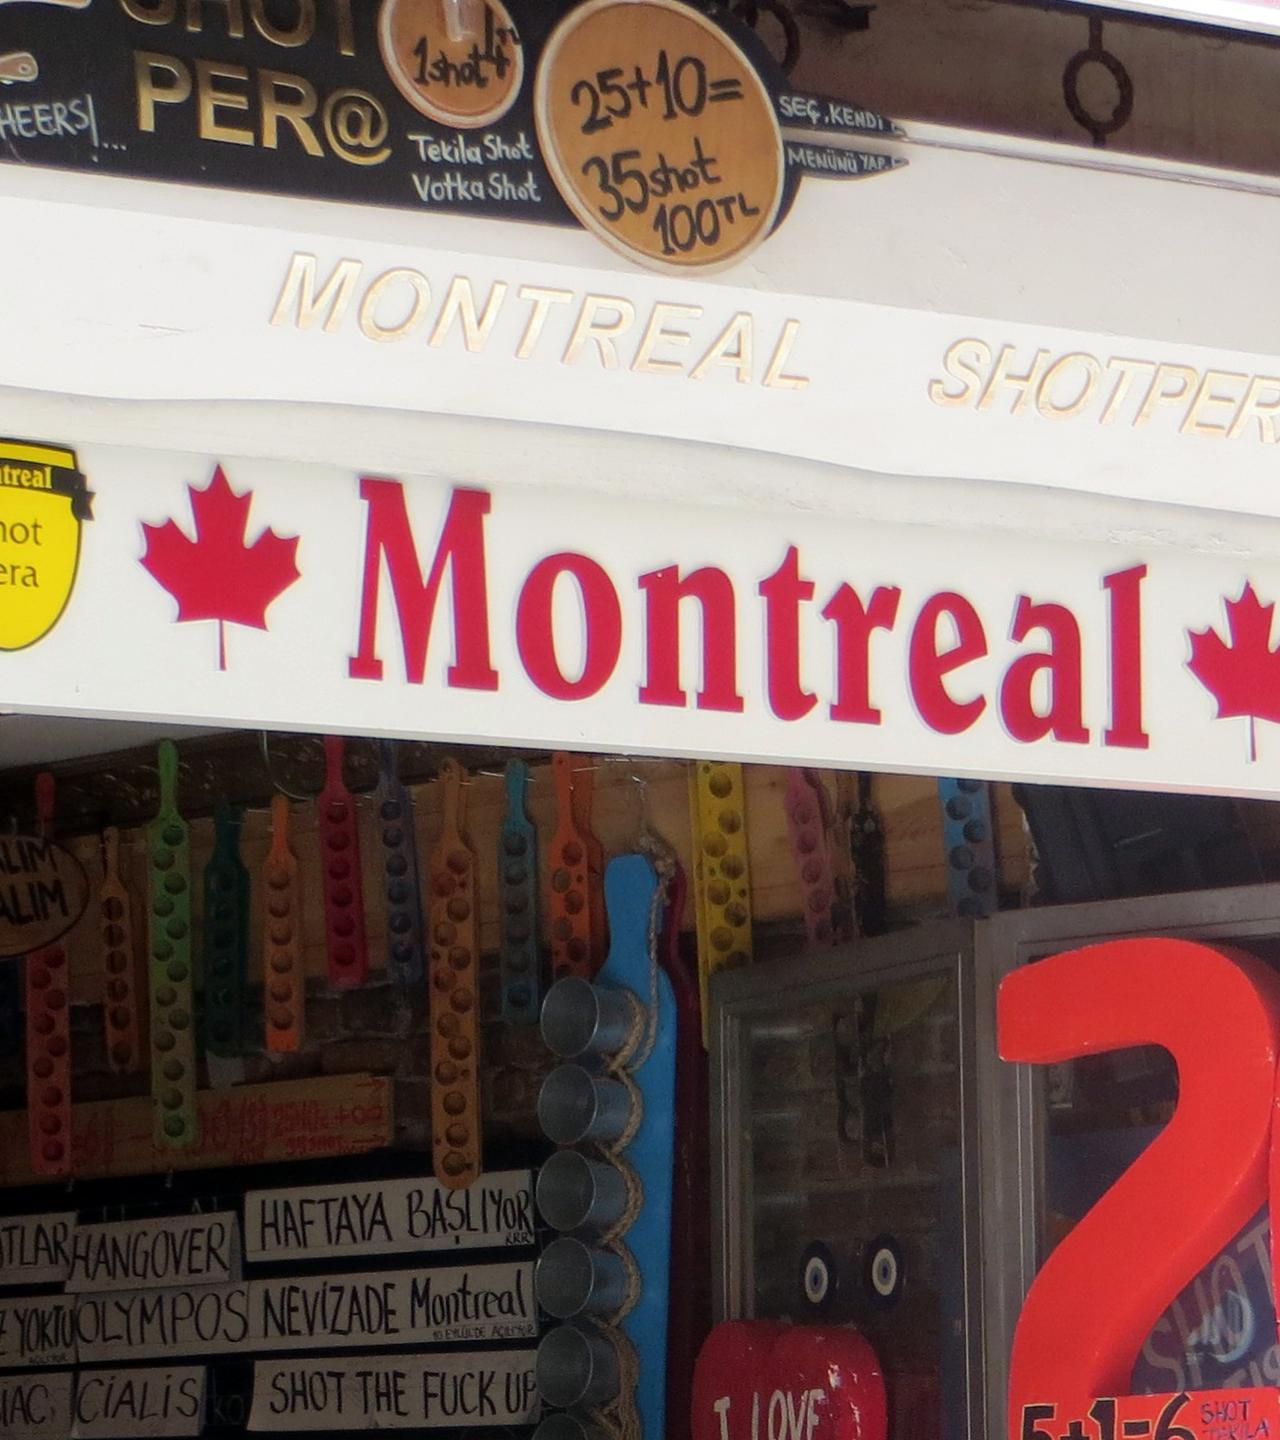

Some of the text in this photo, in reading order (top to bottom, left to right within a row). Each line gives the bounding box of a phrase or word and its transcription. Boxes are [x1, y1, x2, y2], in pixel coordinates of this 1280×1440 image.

[133, 50, 393, 166] PER@
[408, 132, 533, 165] Tekila Shot
[488, 172, 540, 202] Shot
[268, 251, 812, 392] MONTREAL
[347, 476, 1150, 750] Montreal
[260, 1192, 393, 1250] HAFTAYA
[70, 1221, 230, 1281] HANGOVER
[75, 1289, 248, 1347] OLYMPOS
[263, 1268, 527, 1340] NEVİZADE Montreal
[270, 1370, 346, 1415] SHOT
[359, 1370, 408, 1417] THE
[424, 1369, 497, 1420] FUCK
[1199, 1400, 1252, 1425] SHOT
